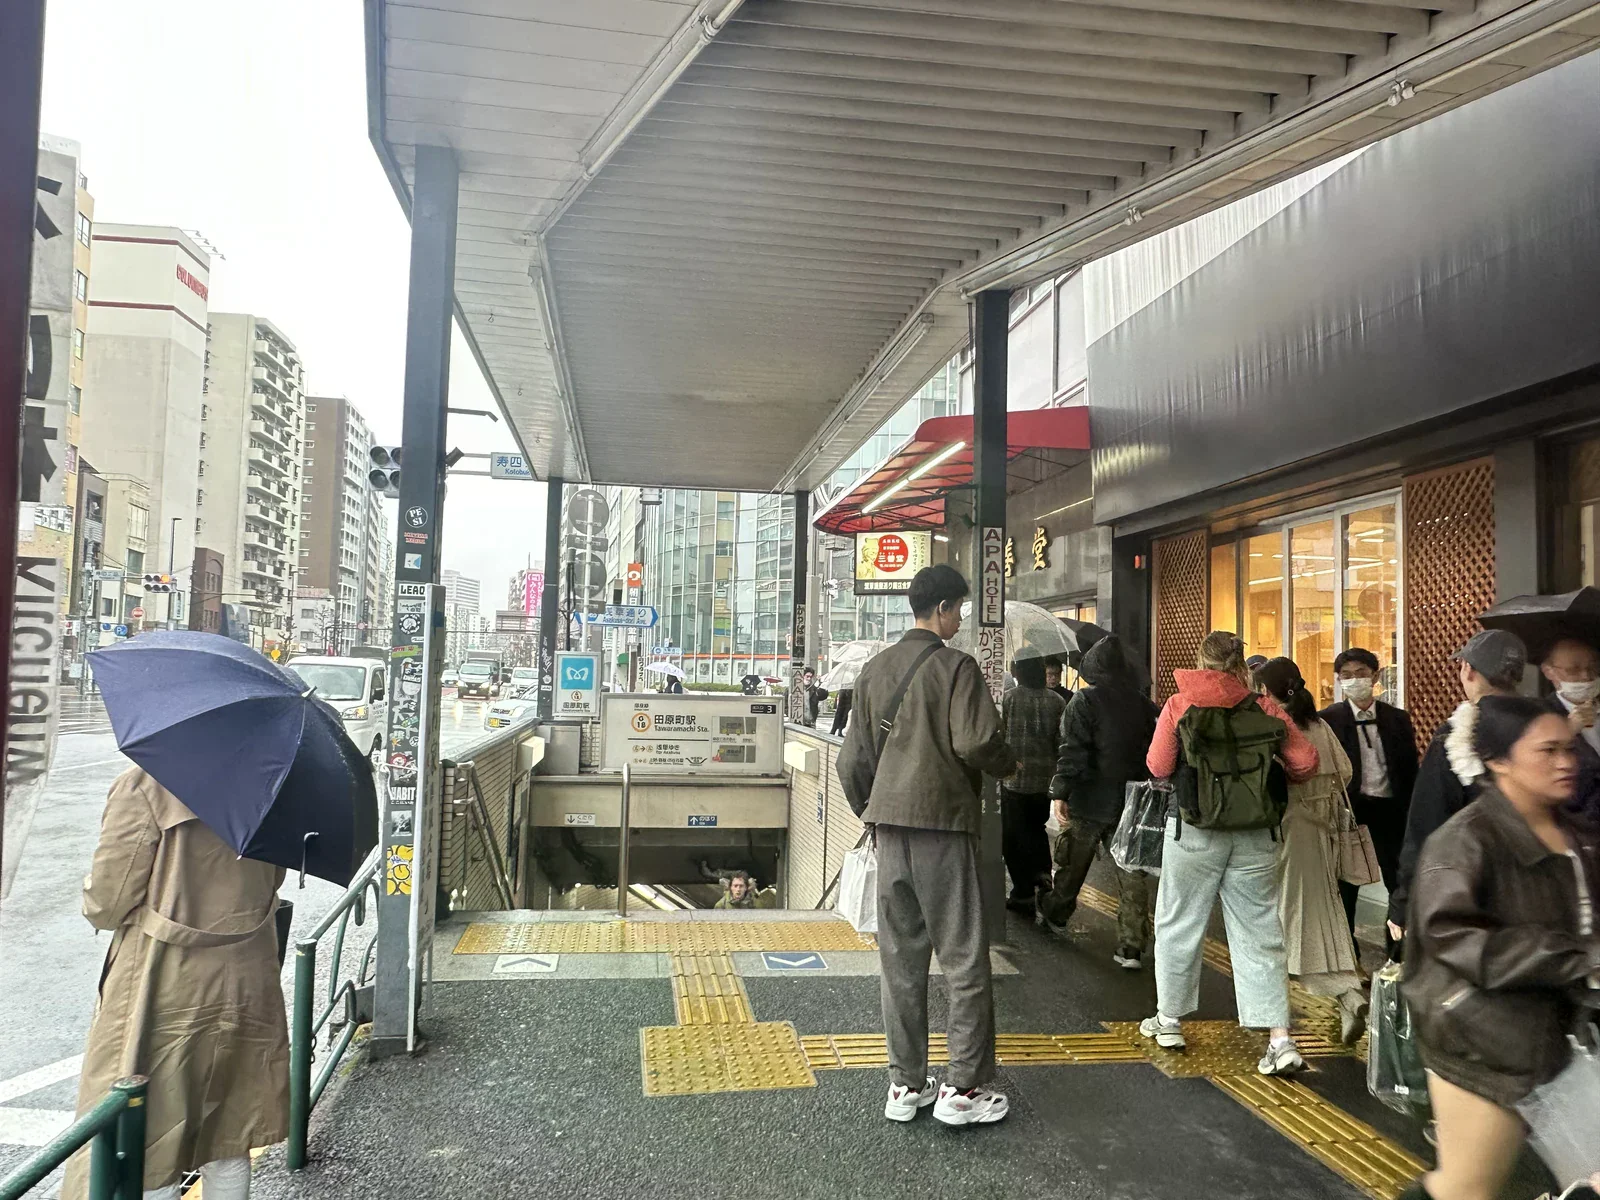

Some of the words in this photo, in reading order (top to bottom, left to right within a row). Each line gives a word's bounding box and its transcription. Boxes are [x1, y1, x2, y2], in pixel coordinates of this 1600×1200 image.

[497, 456, 527, 468] 寿四
[766, 705, 773, 713] 3
[654, 714, 696, 725] 田原町駅
